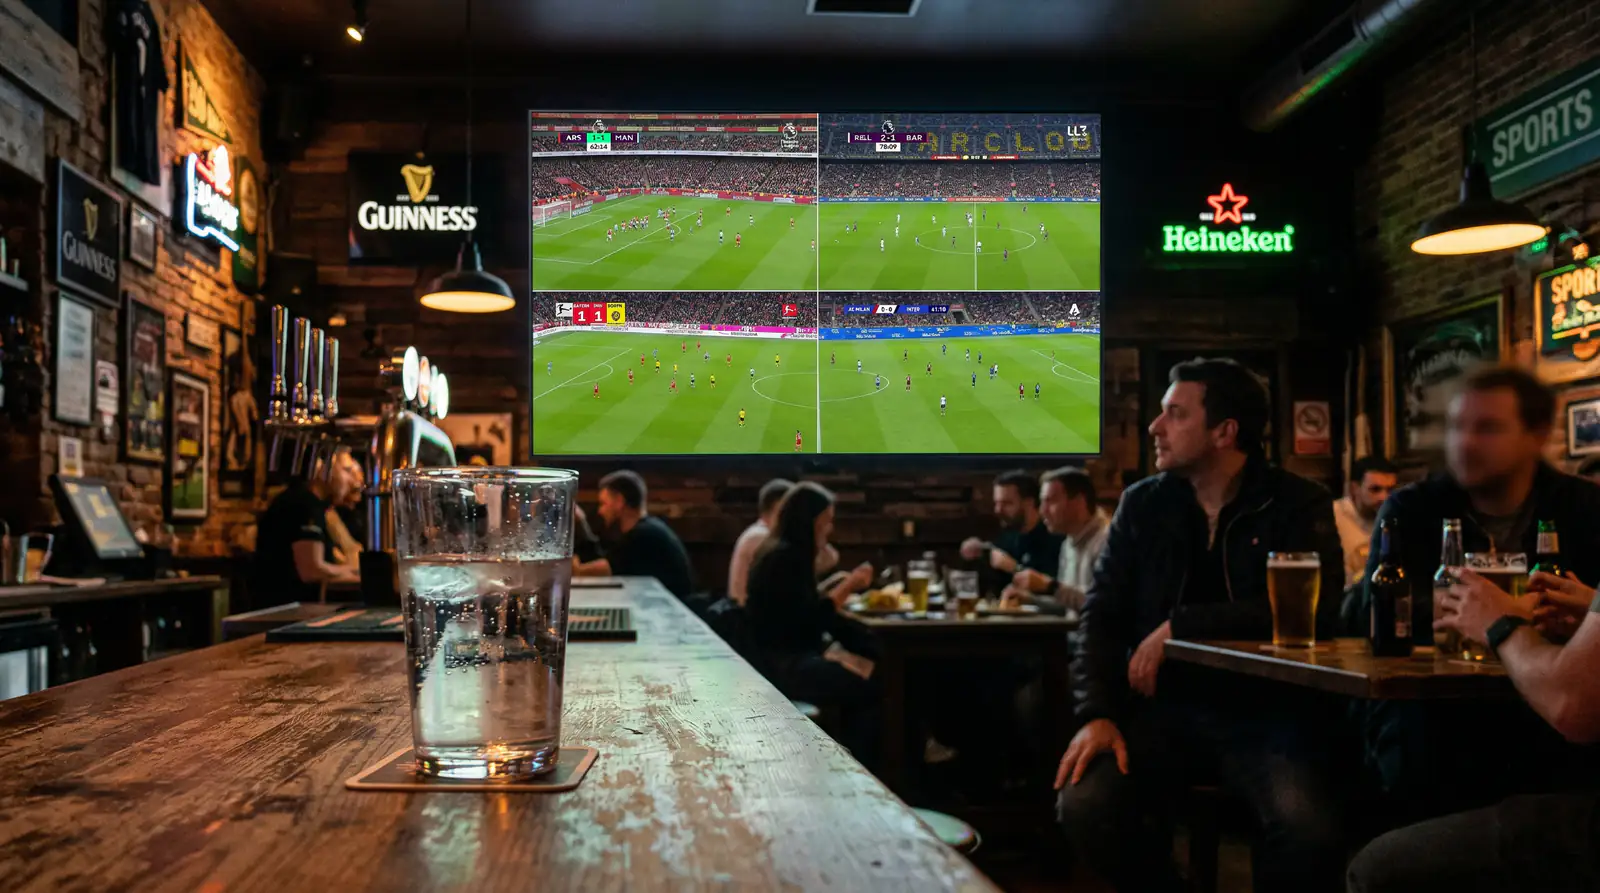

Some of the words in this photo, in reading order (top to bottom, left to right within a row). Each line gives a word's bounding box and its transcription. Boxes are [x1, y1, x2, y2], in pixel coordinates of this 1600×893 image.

[1492, 88, 1593, 168] SPORTS
[358, 201, 477, 231] GUINNESS
[1162, 225, 1294, 252] Heineken
[62, 230, 116, 282] GUINNESS
[1551, 266, 1600, 304] SPOR
[578, 310, 586, 322] 1
[594, 310, 603, 322] 1
